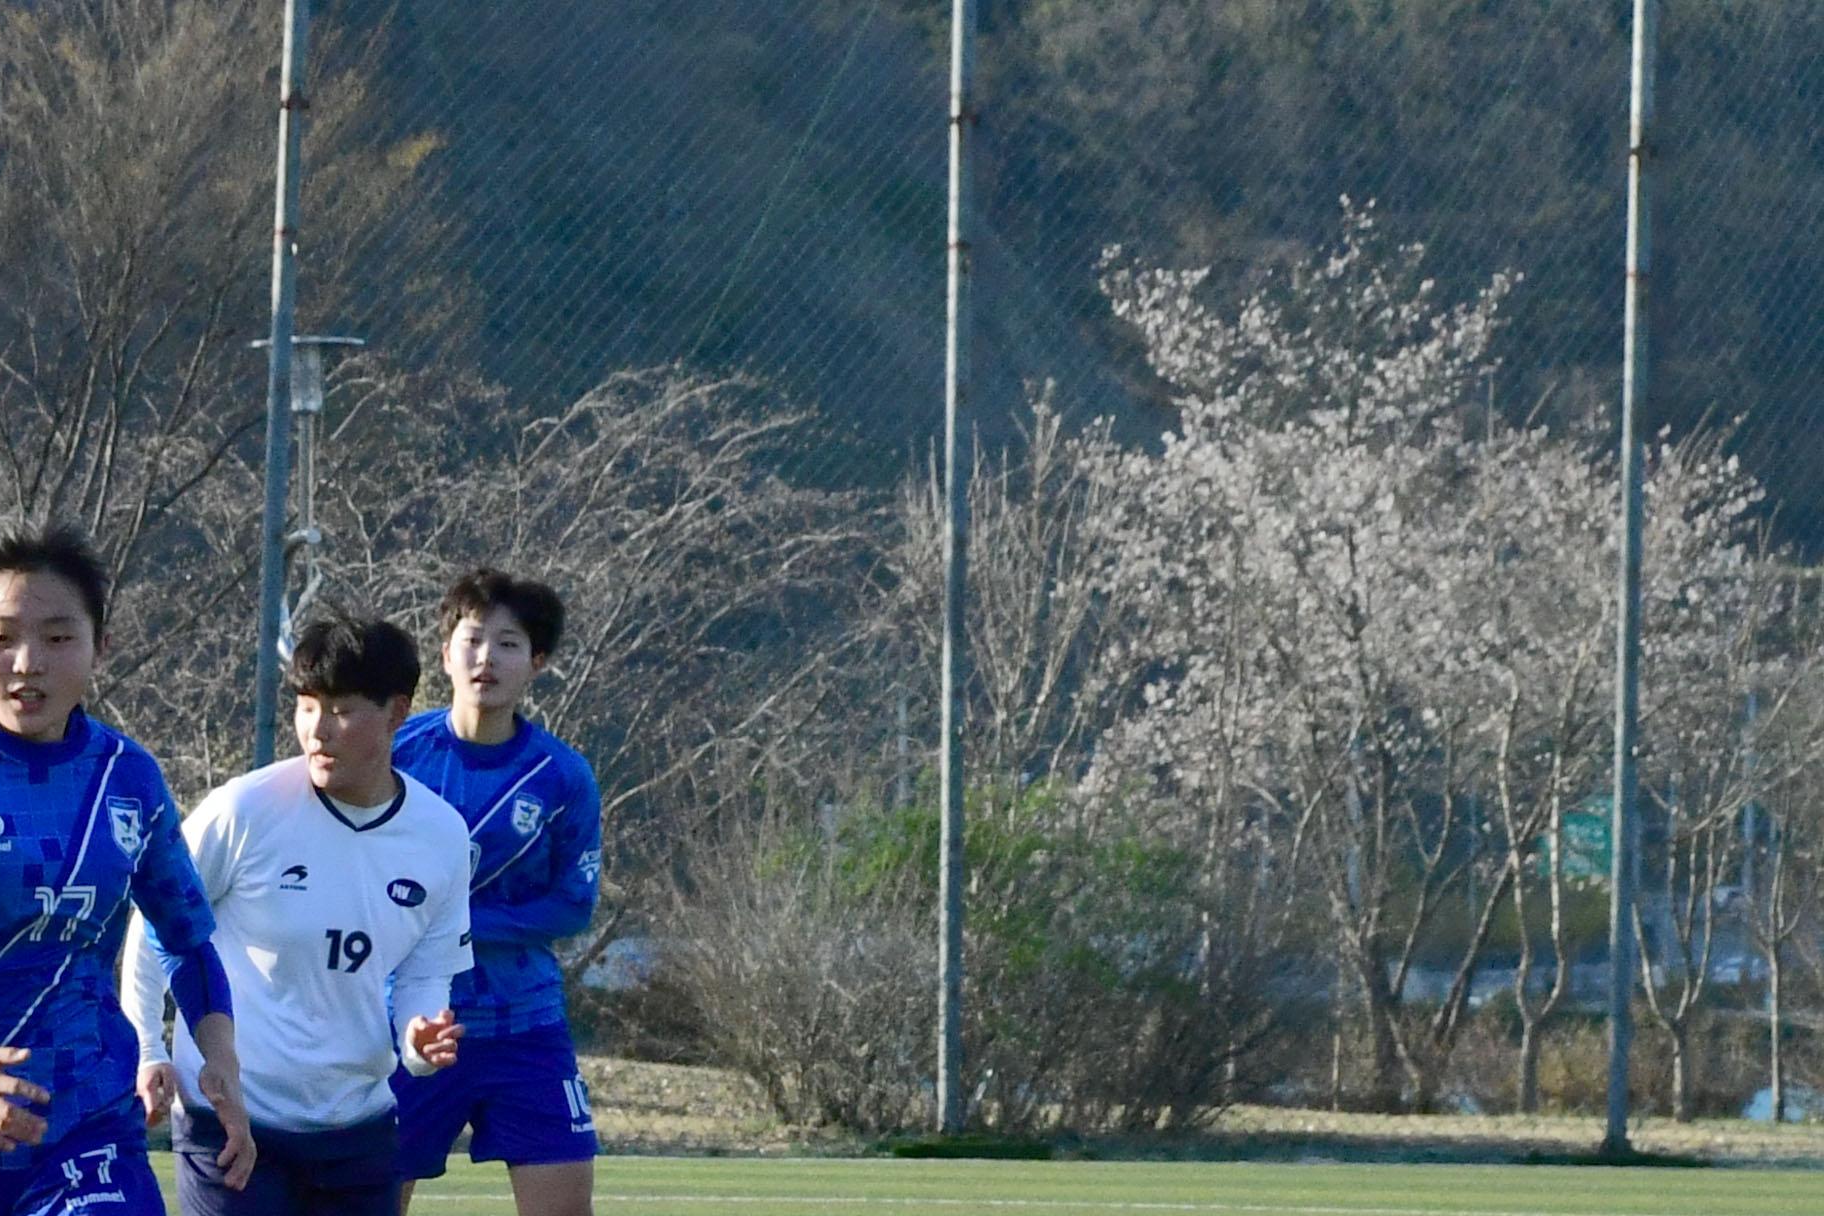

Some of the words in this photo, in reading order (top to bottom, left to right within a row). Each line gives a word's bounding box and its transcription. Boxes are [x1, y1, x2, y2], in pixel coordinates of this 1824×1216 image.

[29, 885, 97, 942] 17
[325, 928, 373, 974] 19
[65, 1189, 127, 1212] hummel
